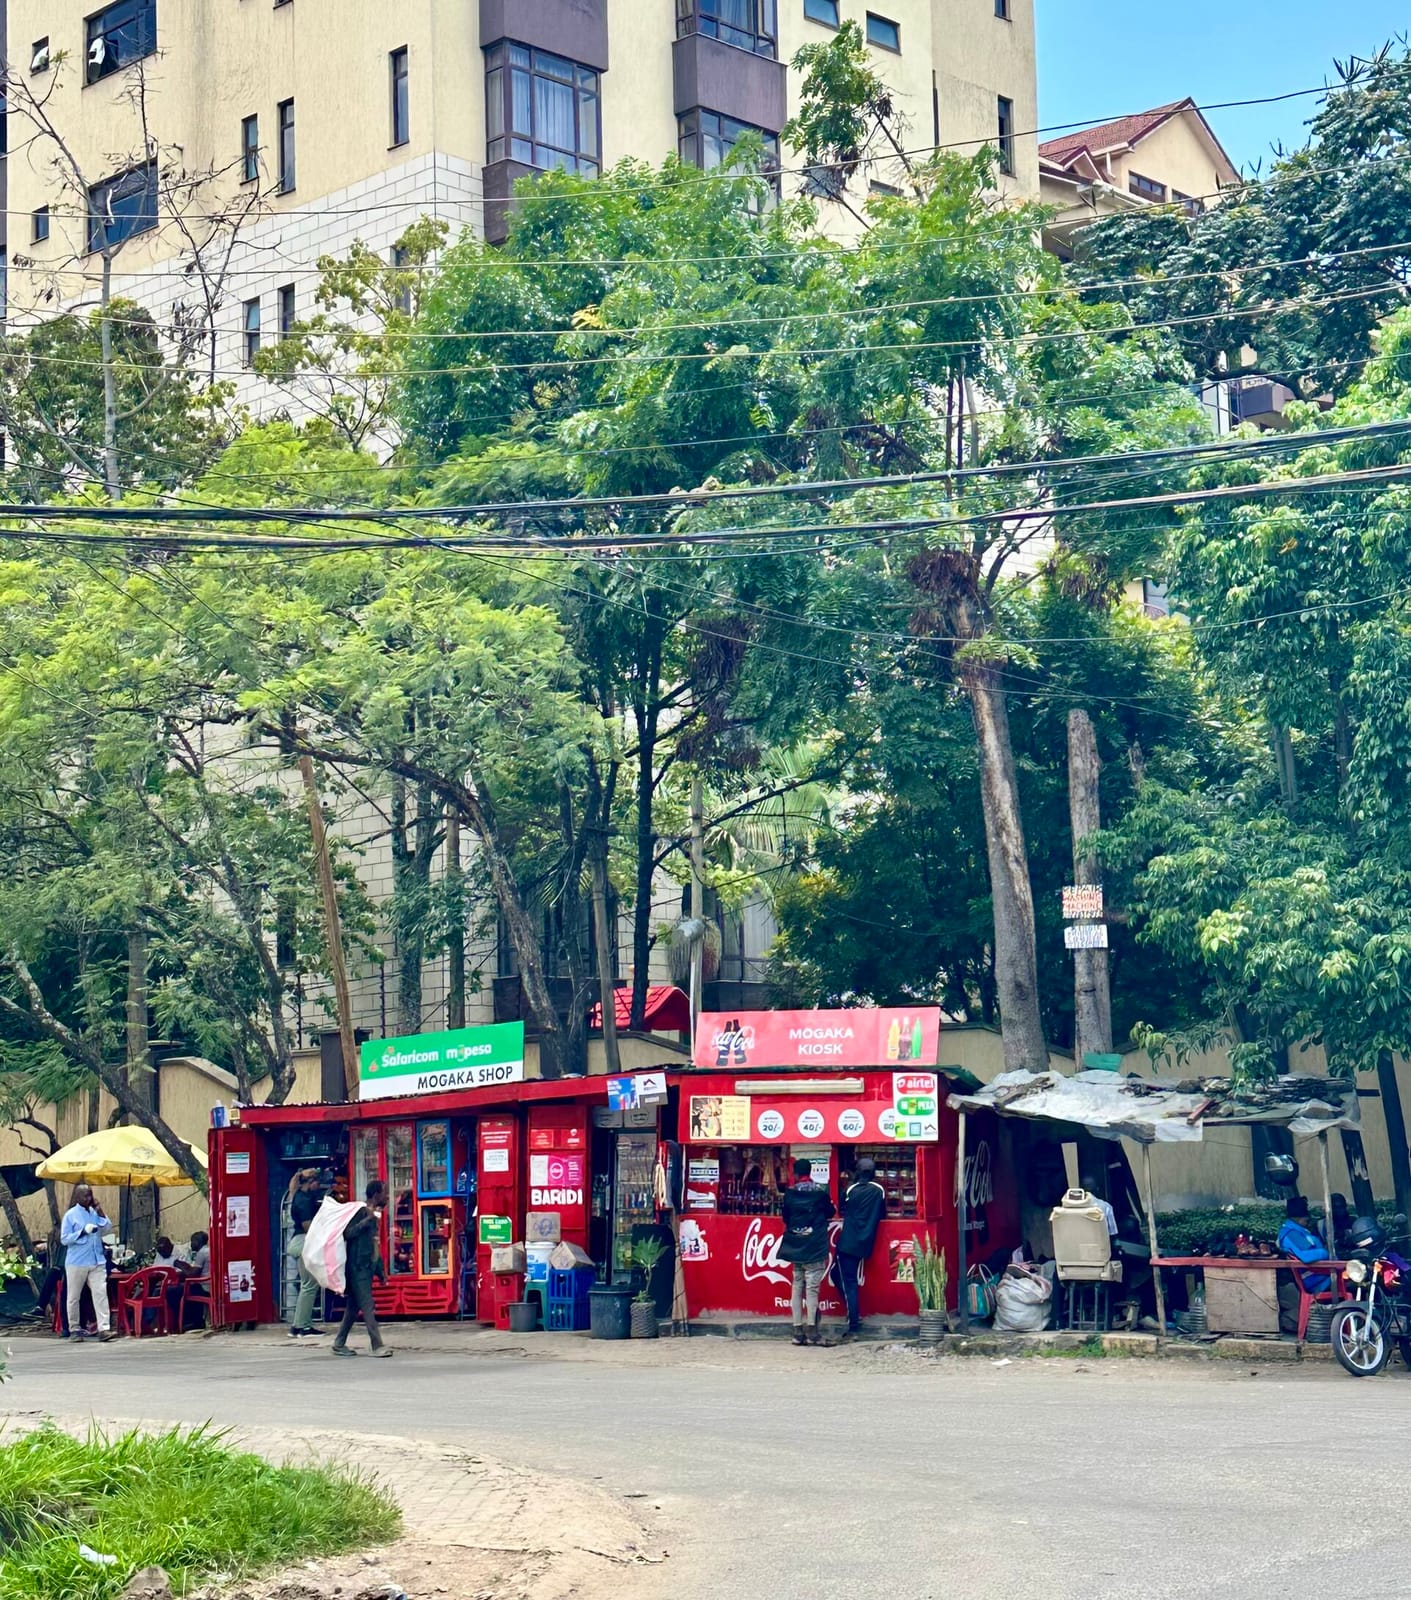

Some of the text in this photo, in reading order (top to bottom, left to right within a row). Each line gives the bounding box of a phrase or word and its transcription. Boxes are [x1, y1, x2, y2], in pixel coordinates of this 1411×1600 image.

[789, 1027, 854, 1040] MOGAKA
[798, 1043, 843, 1055] KIOSK
[381, 1049, 439, 1068] Safaricom
[417, 1066, 513, 1090] MOGAKA SHOP
[906, 1077, 934, 1089] airtel
[531, 1188, 583, 1206] BARIDI
